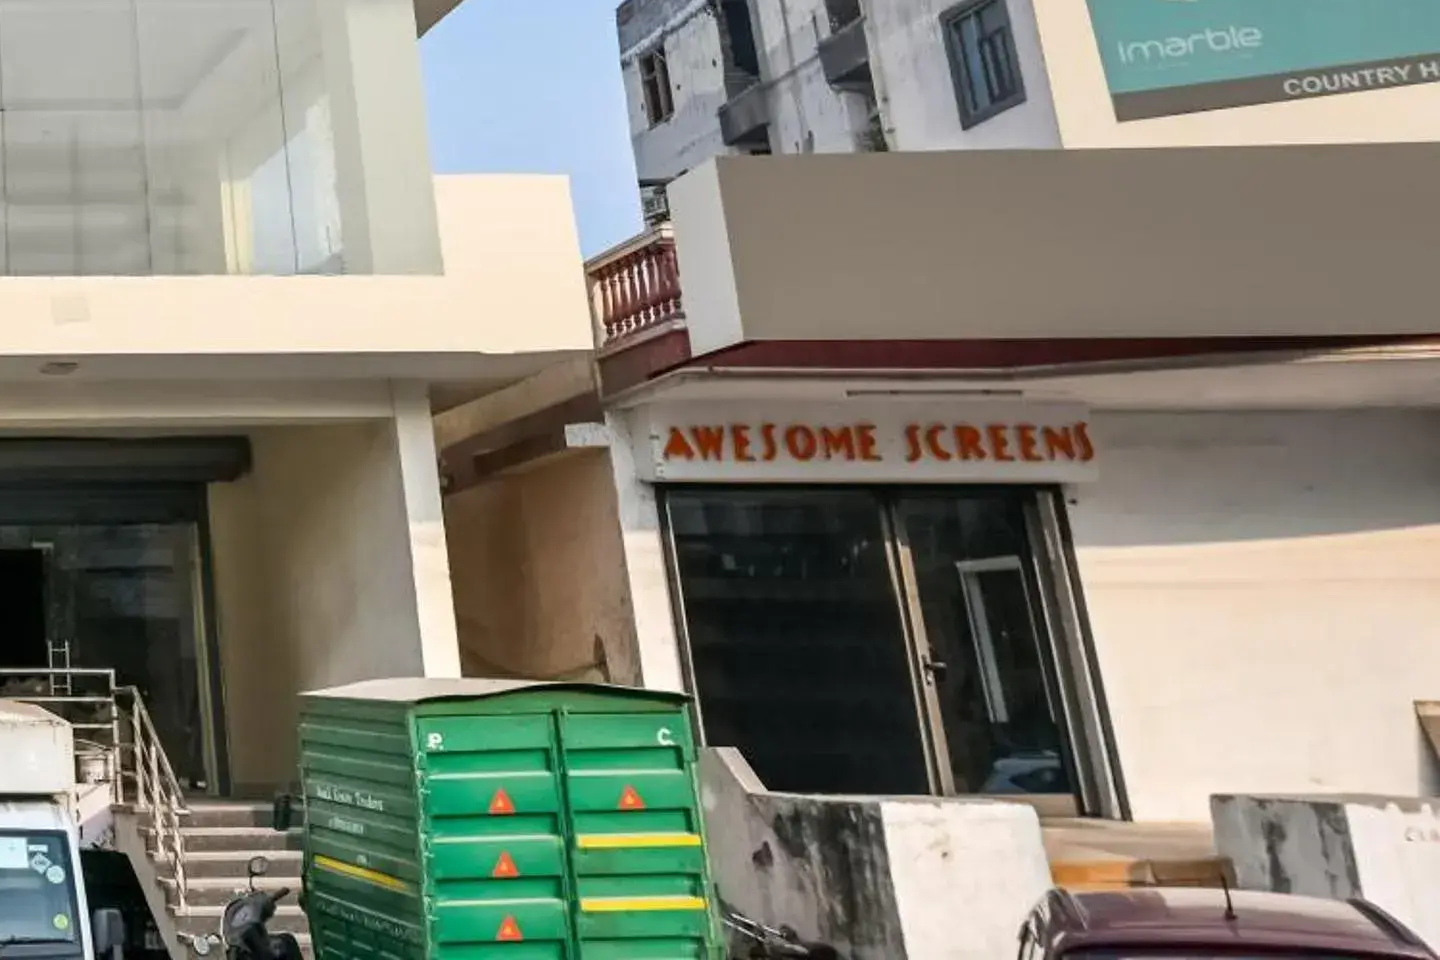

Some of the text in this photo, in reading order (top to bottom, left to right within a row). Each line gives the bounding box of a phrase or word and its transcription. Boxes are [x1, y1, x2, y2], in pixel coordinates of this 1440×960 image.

[1283, 63, 1412, 96] COUNTRY
[663, 420, 1095, 463] AWESOME SCREENS
